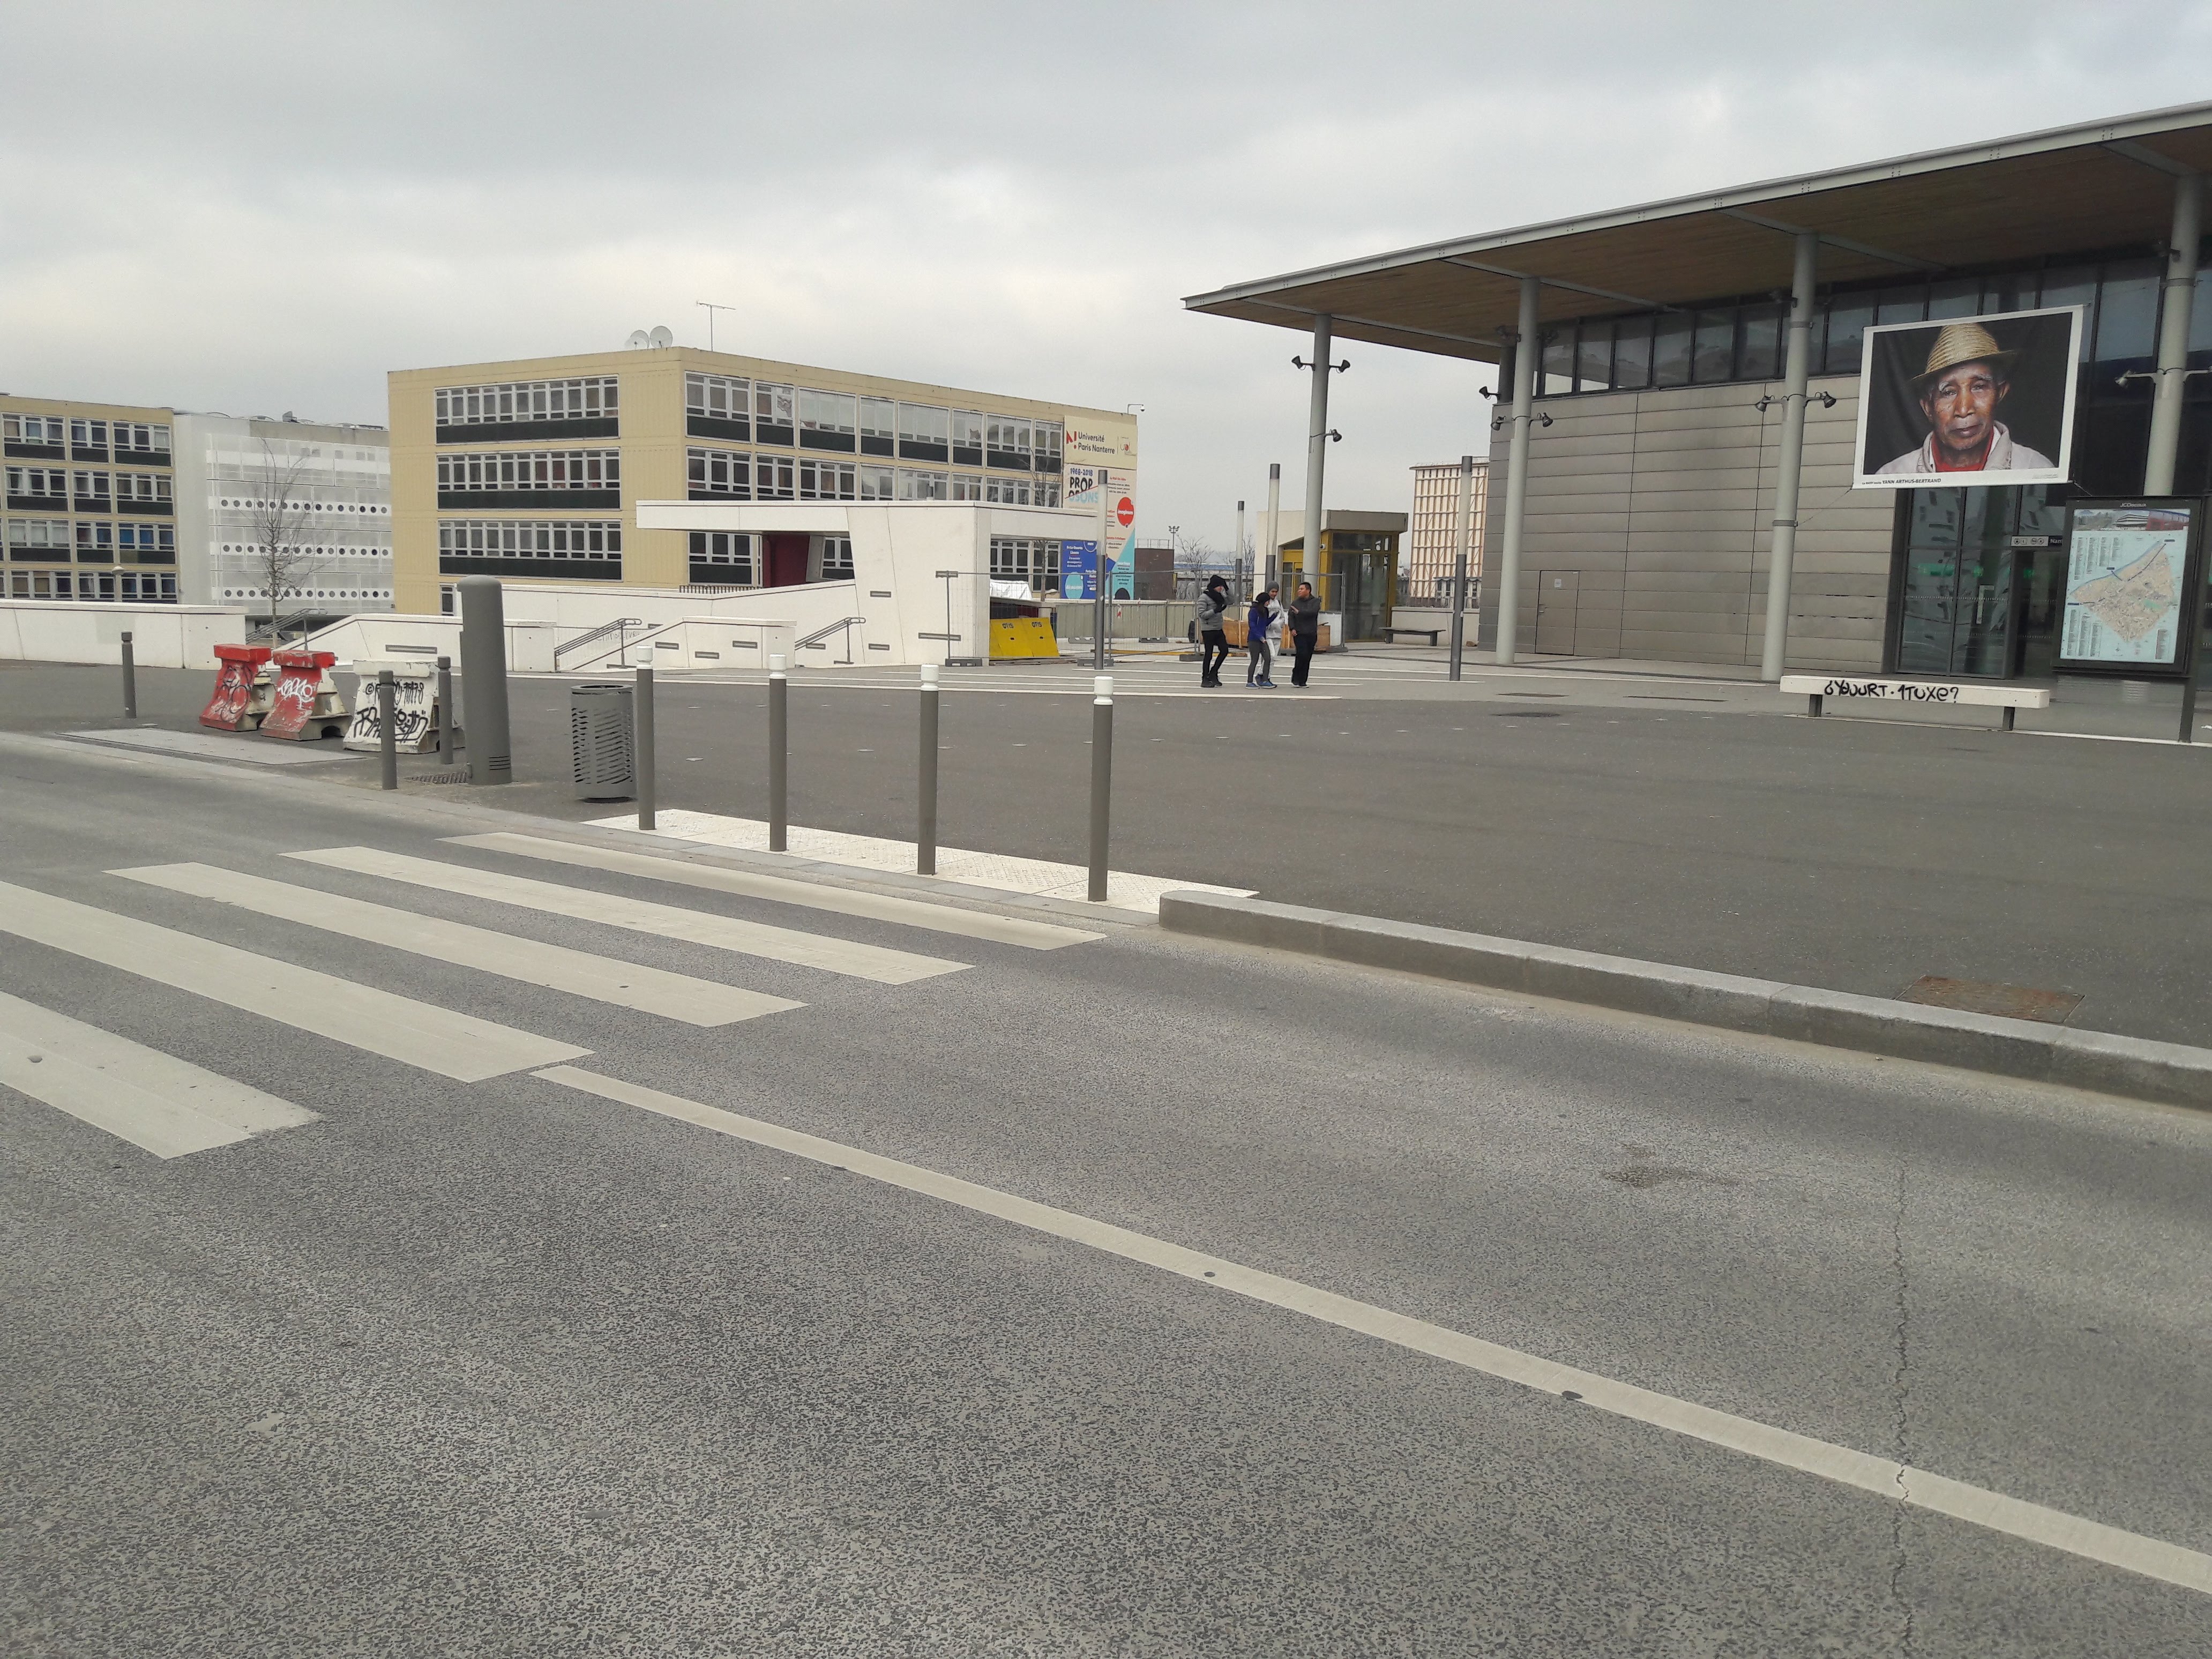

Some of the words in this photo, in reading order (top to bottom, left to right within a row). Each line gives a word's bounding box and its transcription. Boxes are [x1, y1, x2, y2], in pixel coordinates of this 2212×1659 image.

[1078, 431, 1105, 443] Université
[1078, 442, 1091, 452] Paris
[1092, 444, 1115, 454] Nanterre
[1070, 467, 1093, 476] 1968-2018
